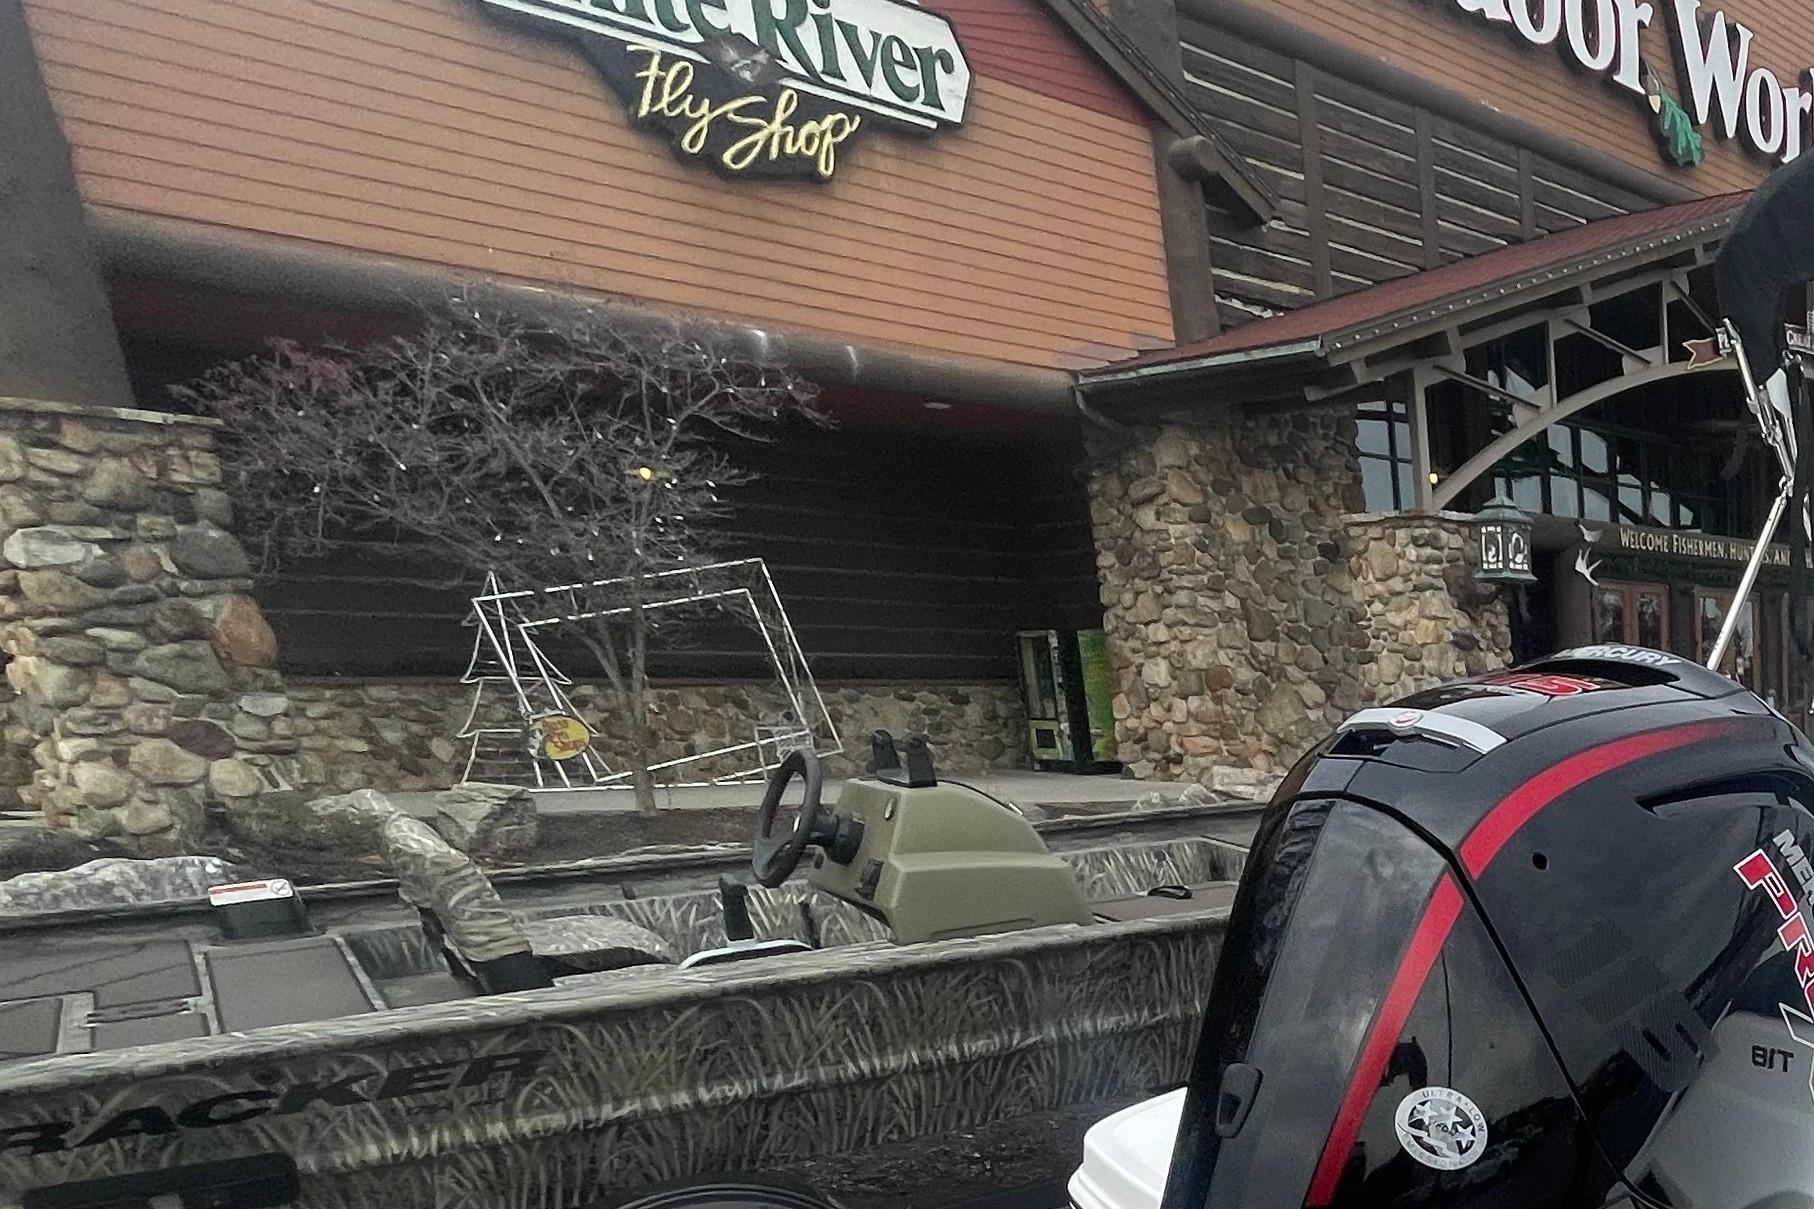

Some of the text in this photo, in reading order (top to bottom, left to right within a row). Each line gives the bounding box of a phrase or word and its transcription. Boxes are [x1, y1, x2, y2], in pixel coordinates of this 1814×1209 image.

[626, 44, 862, 177] Fly Shop
[755, 0, 955, 112] River
[1619, 527, 1669, 553] WELCOME
[1729, 542, 1772, 564] HUNTS,
